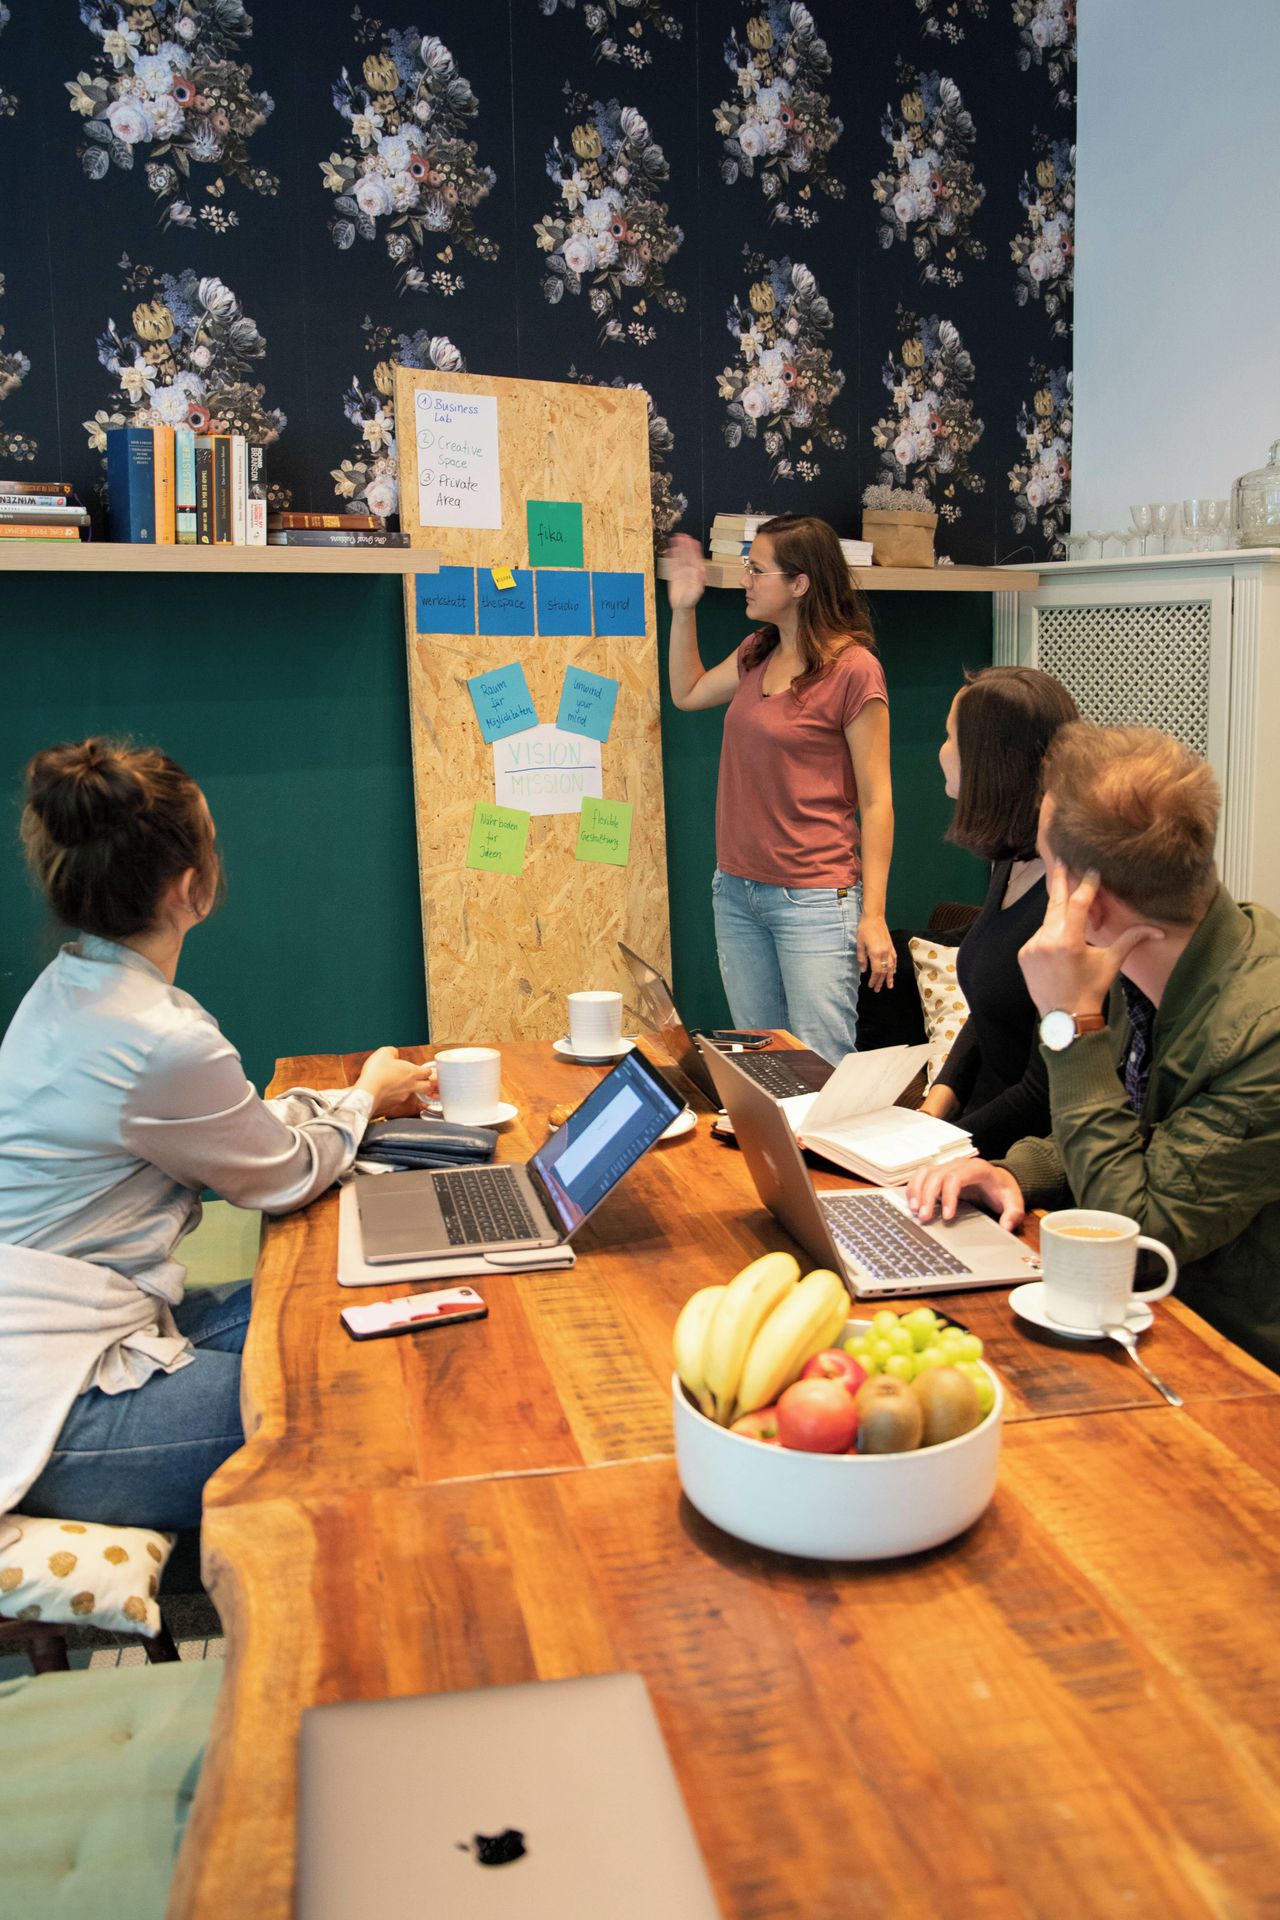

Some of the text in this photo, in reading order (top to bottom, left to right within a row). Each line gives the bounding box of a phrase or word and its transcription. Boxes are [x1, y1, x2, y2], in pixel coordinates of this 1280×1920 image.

[434, 398, 479, 414] Business
[434, 412, 453, 423] Lab
[438, 435, 483, 457] Creative
[250, 447, 259, 481] BRANSON
[438, 455, 467, 469] Space
[439, 473, 479, 493] Private
[436, 492, 461, 509] Area
[537, 523, 565, 547] fika
[547, 597, 579, 611] studio
[480, 680, 507, 696] Raum
[567, 713, 588, 727] mind
[508, 741, 582, 766] VISION
[511, 773, 585, 796] MISSION
